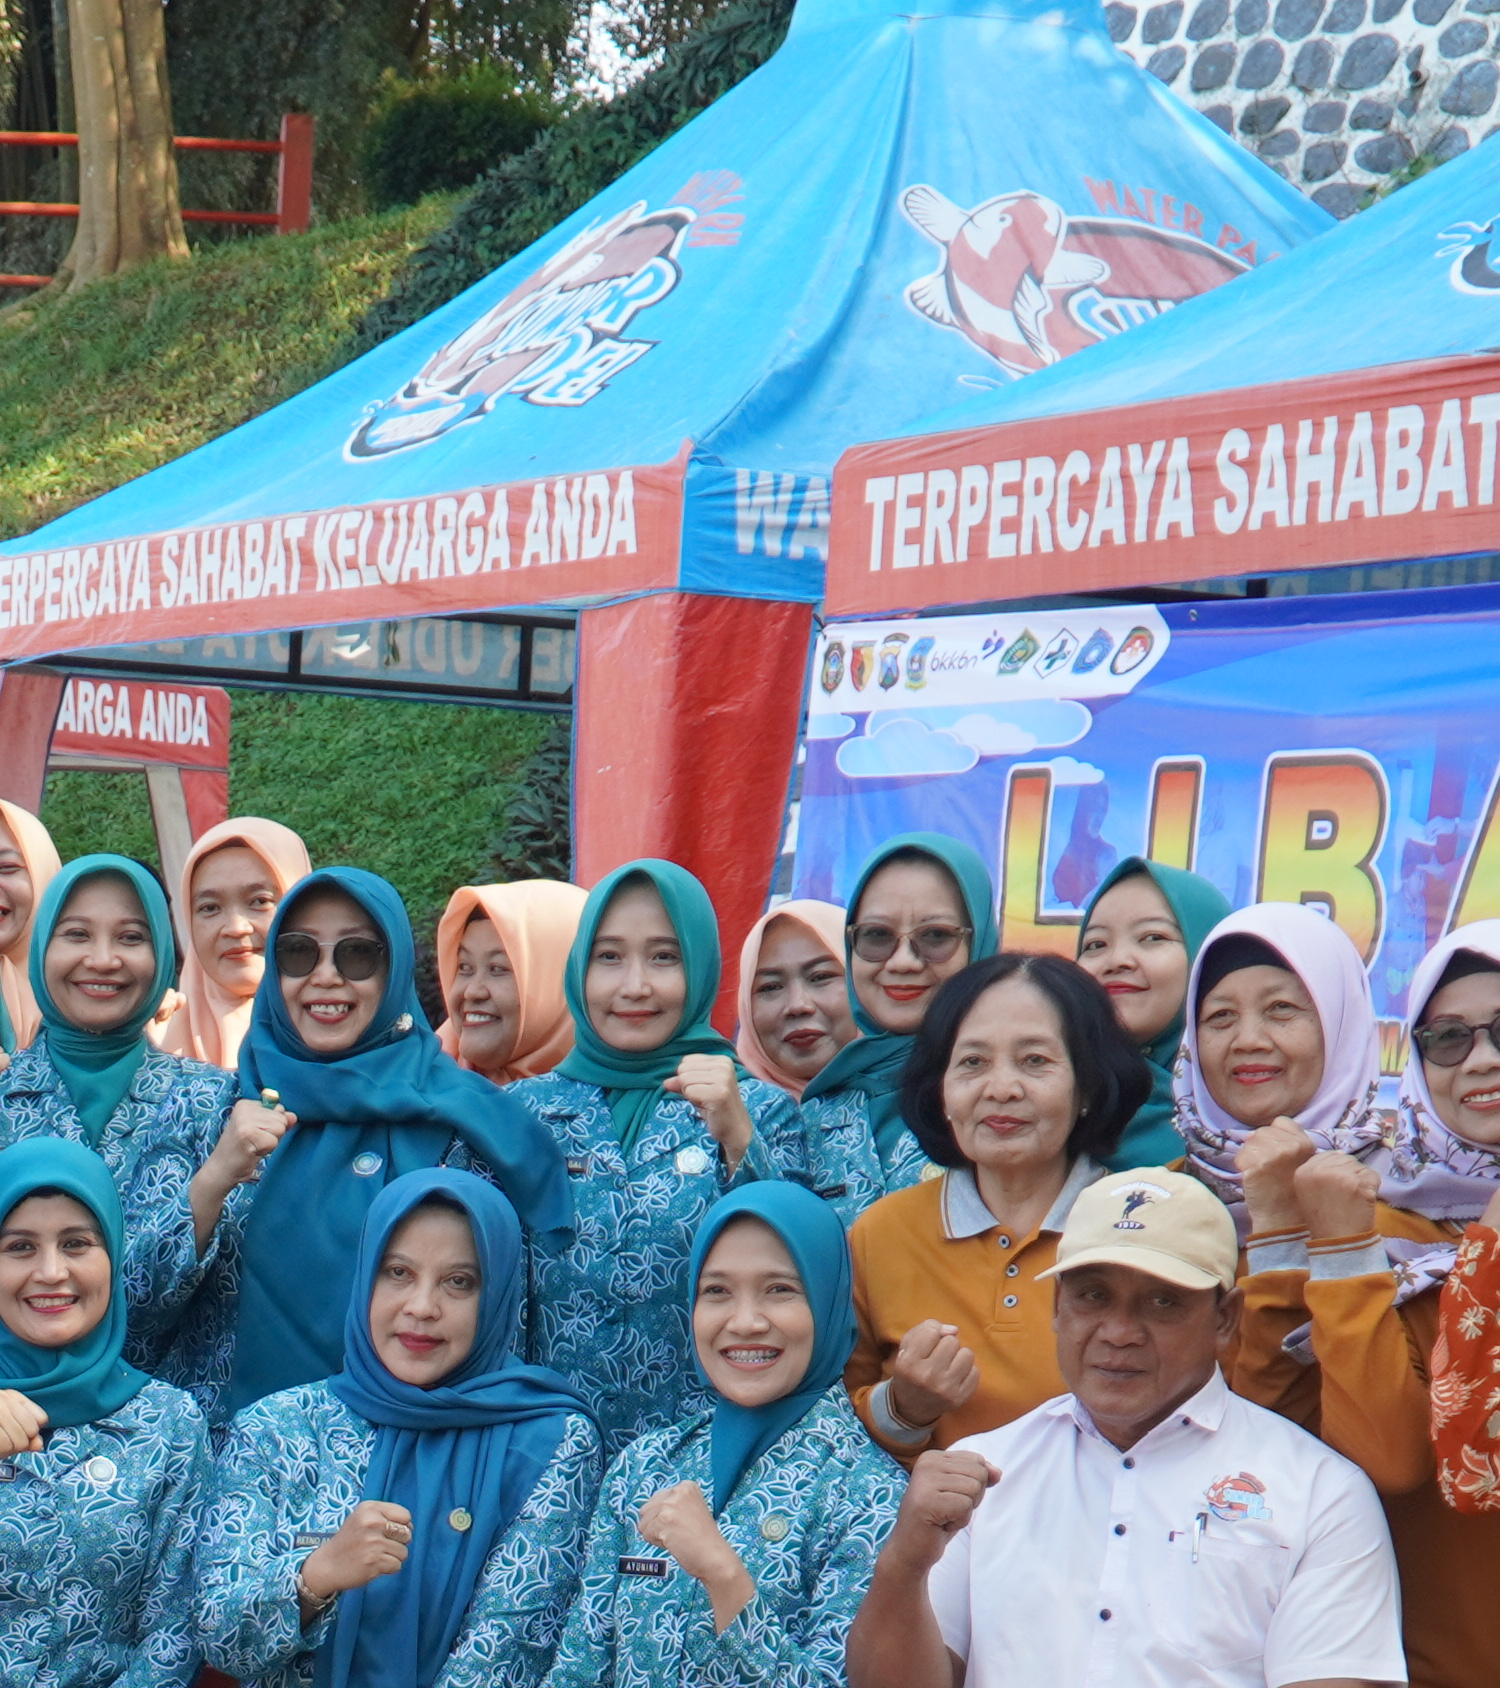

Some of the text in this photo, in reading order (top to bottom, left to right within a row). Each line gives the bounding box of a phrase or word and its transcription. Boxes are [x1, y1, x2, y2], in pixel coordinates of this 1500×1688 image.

[1082, 176, 1282, 265] WATER PA
[160, 514, 307, 609] SAHABAT
[312, 488, 510, 592] KELUARGA
[520, 469, 638, 568] ANDA
[864, 436, 1195, 572] TERPERCAYA
[138, 688, 210, 747] ANDA
